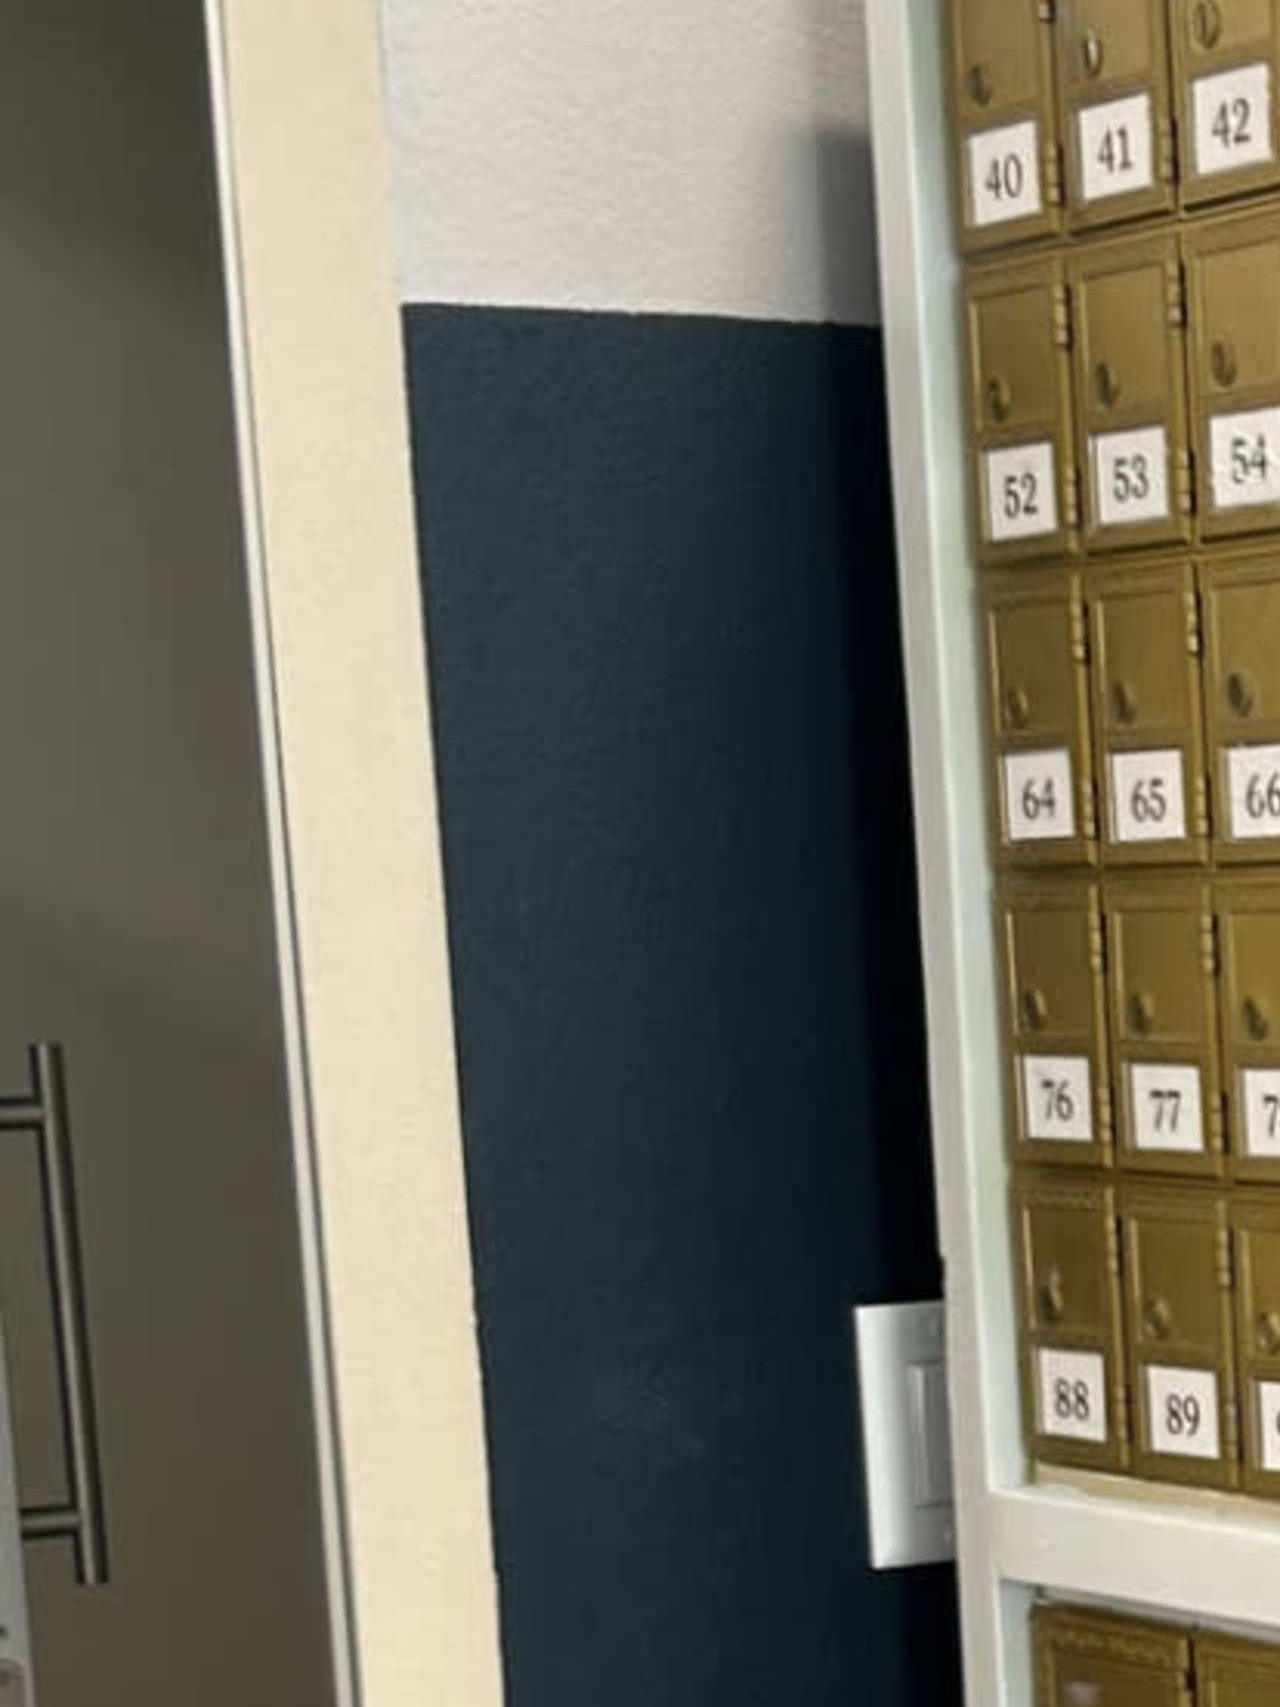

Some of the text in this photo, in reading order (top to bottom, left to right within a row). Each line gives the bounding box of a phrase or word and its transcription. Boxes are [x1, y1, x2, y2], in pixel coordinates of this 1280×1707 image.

[1211, 97, 1252, 148] 42
[1097, 126, 1133, 174] 41
[984, 152, 1024, 200] 40
[1112, 453, 1150, 504] 53
[1230, 433, 1269, 486] 54
[1003, 470, 1039, 520] 52
[1021, 777, 1057, 821] 64
[1129, 777, 1167, 824] 65
[1039, 1078, 1074, 1123] 76
[1148, 1088, 1182, 1132] 77
[1053, 1377, 1090, 1422] 88
[1165, 1393, 1201, 1437] 89
